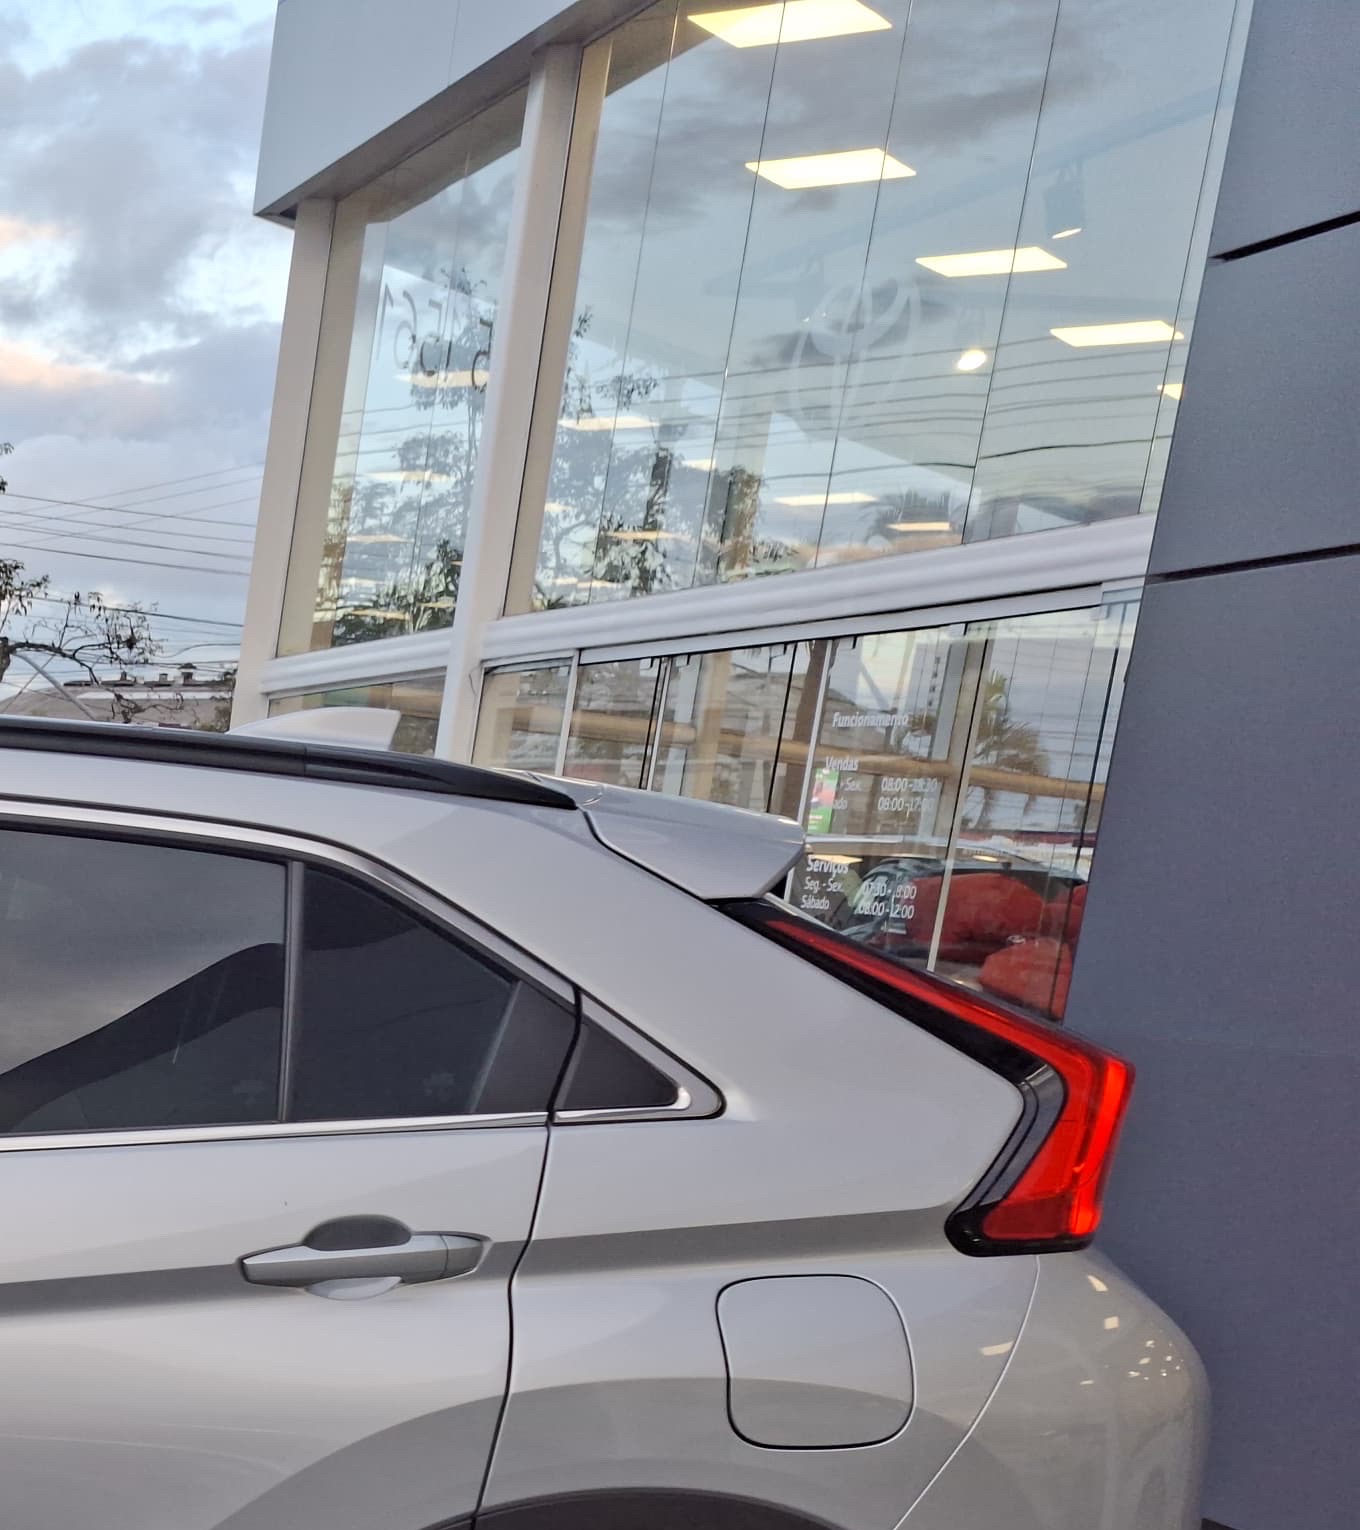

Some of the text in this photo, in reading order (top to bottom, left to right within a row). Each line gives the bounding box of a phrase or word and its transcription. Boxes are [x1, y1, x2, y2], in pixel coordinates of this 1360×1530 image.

[831, 711, 909, 729] Funcionamento
[825, 756, 859, 771] Vendas
[806, 854, 849, 878] Serviços
